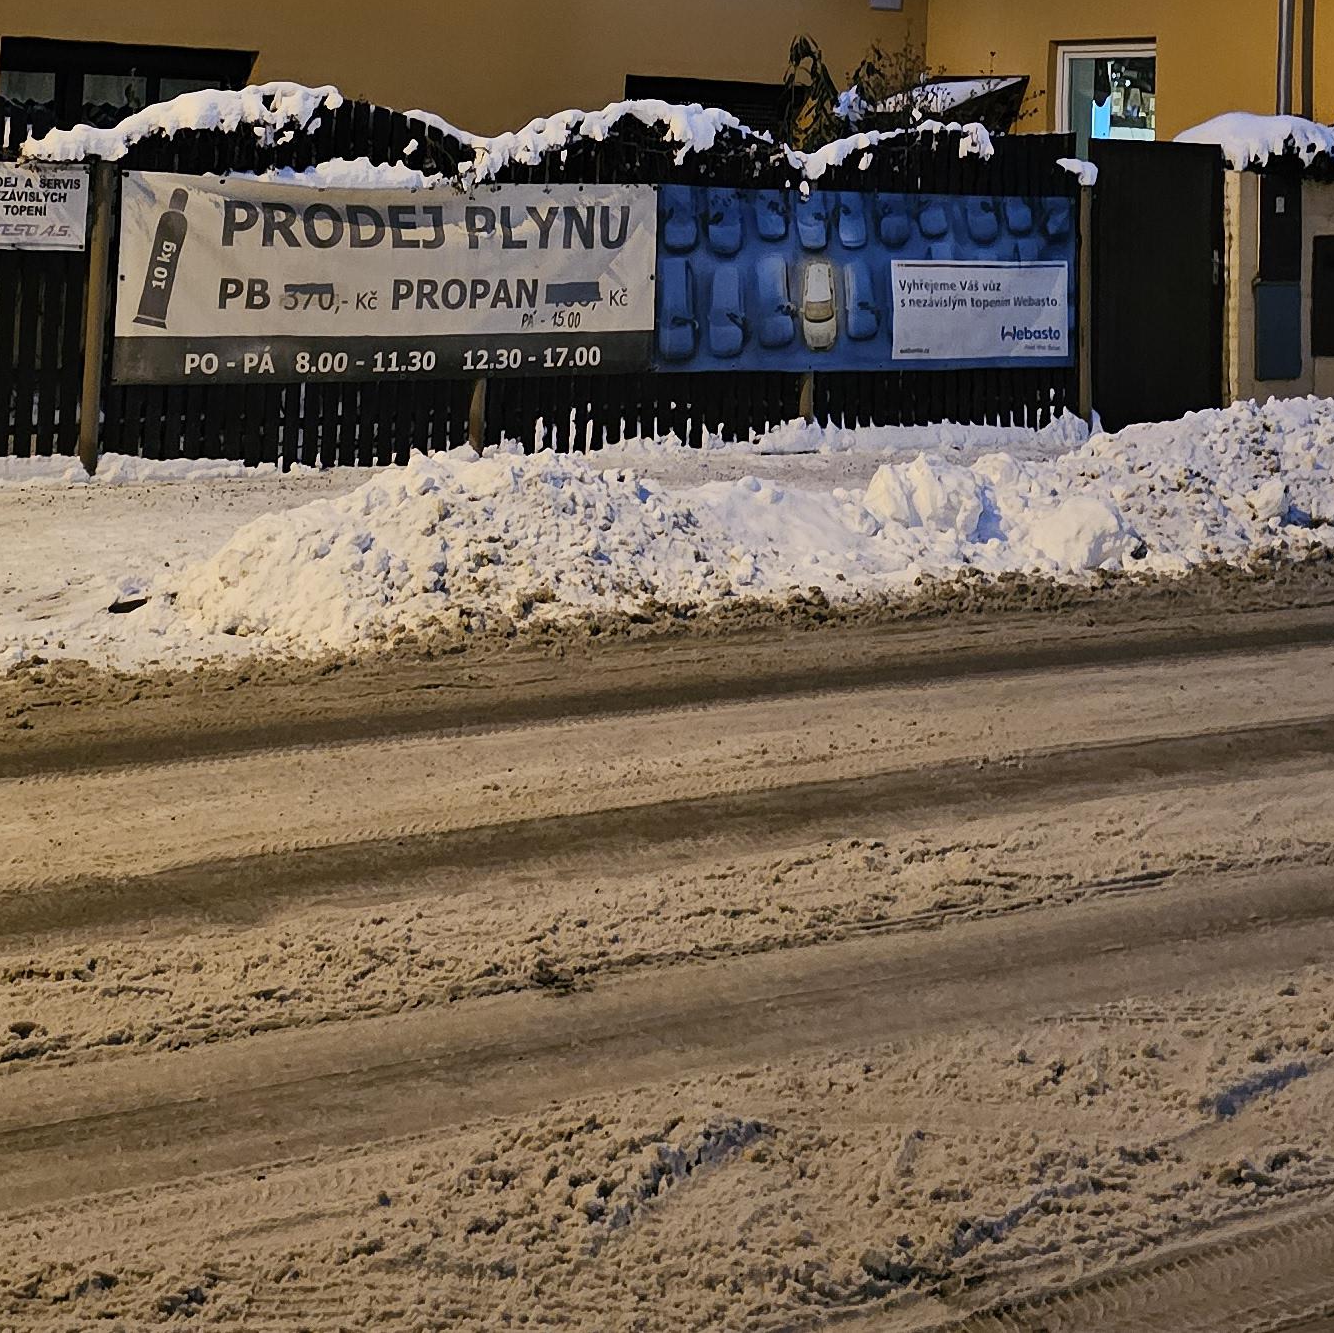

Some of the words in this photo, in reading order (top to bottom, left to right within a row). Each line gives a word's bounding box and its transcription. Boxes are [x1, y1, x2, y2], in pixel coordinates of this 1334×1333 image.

[24, 177, 34, 188] A
[39, 177, 81, 190] SERVIS
[3, 203, 47, 216] TOPENÍ
[222, 200, 445, 250] PRODEJ
[465, 205, 630, 250] PLYNU
[157, 240, 177, 263] kg
[151, 266, 168, 290] 10
[959, 279, 979, 291] Váš
[982, 279, 1001, 292] vůz
[218, 277, 271, 310] PB
[356, 290, 379, 310] Kč
[391, 278, 539, 310] PROPAN
[609, 287, 628, 307] Kč
[900, 298, 906, 308] s
[909, 296, 967, 310] nezávislým
[1001, 326, 1061, 341] Webasto
[184, 353, 218, 374] PO
[243, 346, 275, 374] PÁ
[295, 352, 348, 373] 8.00
[372, 351, 436, 372] 11.30
[462, 348, 522, 371] 12.30
[543, 346, 601, 367] 17.00
